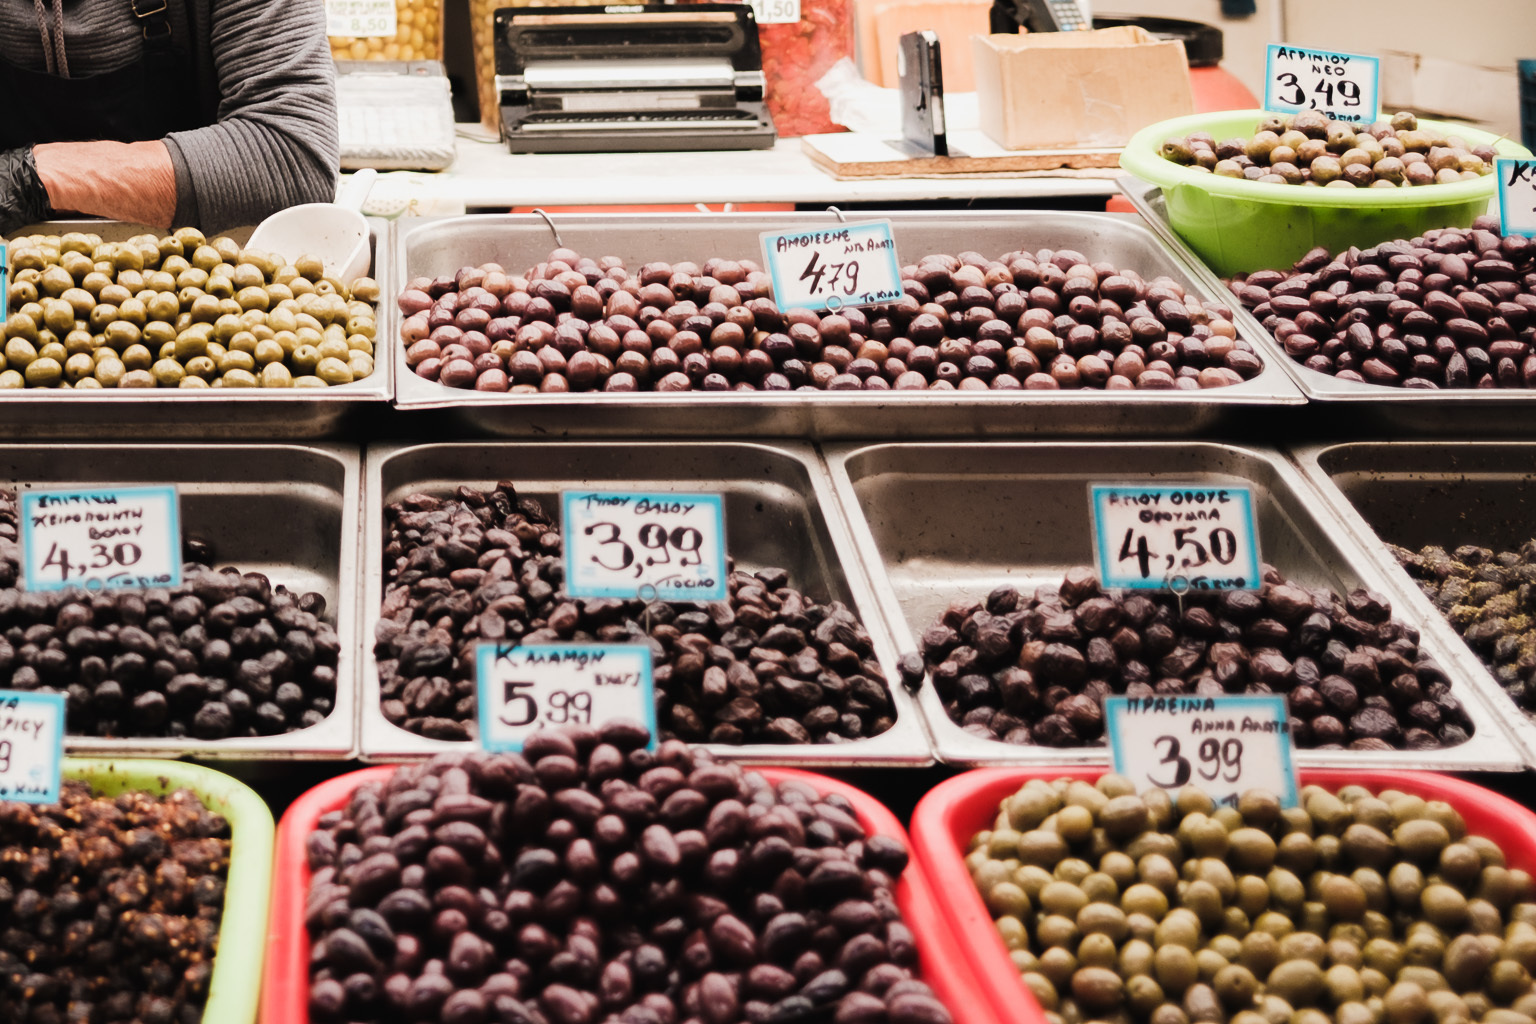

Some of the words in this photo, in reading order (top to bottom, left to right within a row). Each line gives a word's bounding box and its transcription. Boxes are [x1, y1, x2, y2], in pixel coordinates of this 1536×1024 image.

[351, 18, 387, 33] 8,50
[747, 0, 794, 21] 1,50
[1277, 46, 1350, 65] ΑΓΡΙΝΙΟΥ
[1276, 72, 1361, 109] 3,49
[41, 542, 142, 581] 4,30
[584, 522, 703, 578] 3,99
[1118, 526, 1237, 579] 4,50
[498, 681, 592, 729] 5,99
